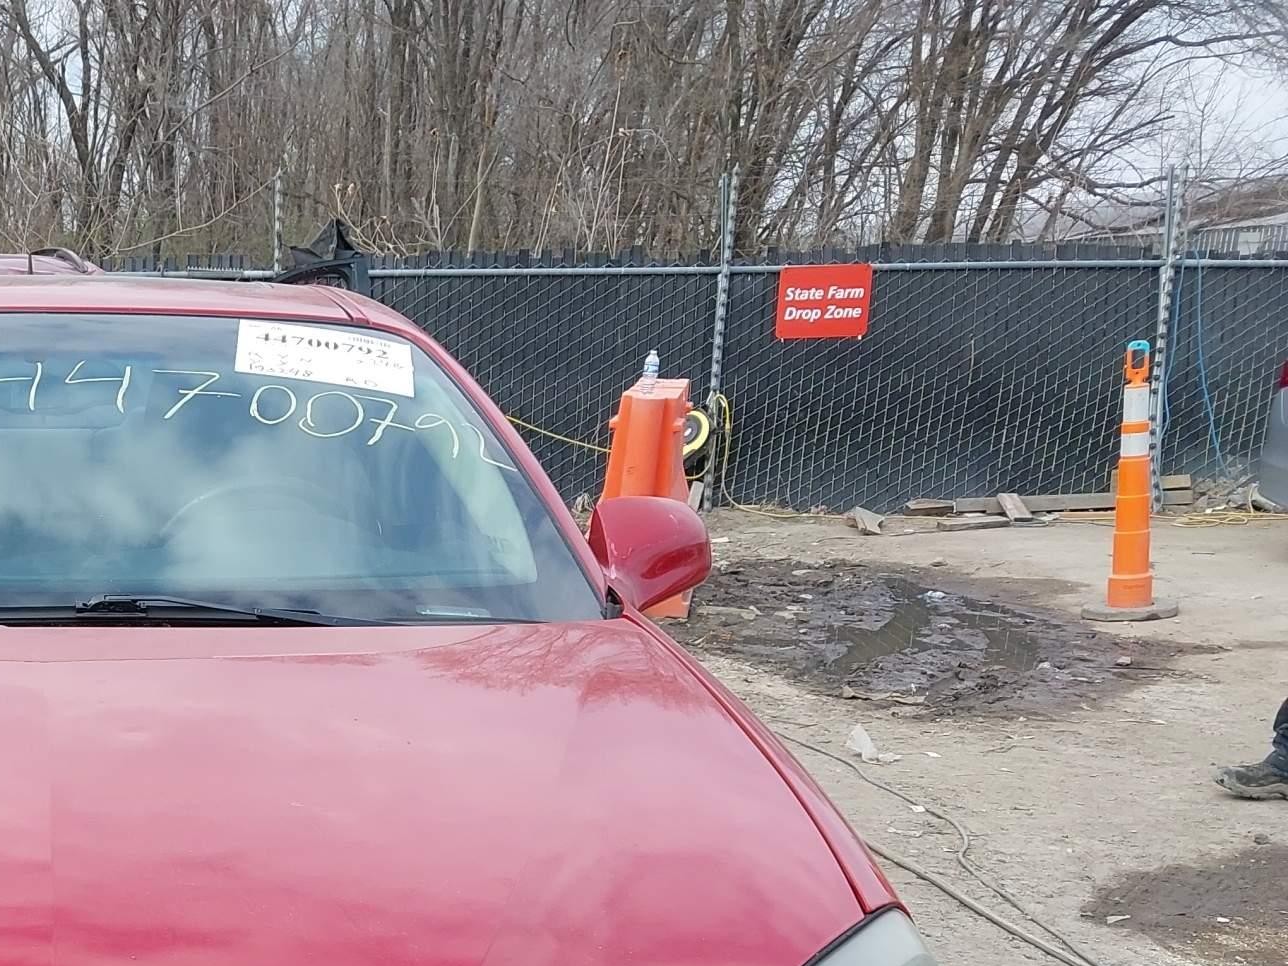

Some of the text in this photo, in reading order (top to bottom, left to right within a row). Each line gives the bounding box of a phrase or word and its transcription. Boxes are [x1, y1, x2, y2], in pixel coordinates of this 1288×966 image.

[785, 285, 865, 301] State Farm
[783, 304, 862, 323] Drop Zone
[255, 332, 390, 360] 44700792
